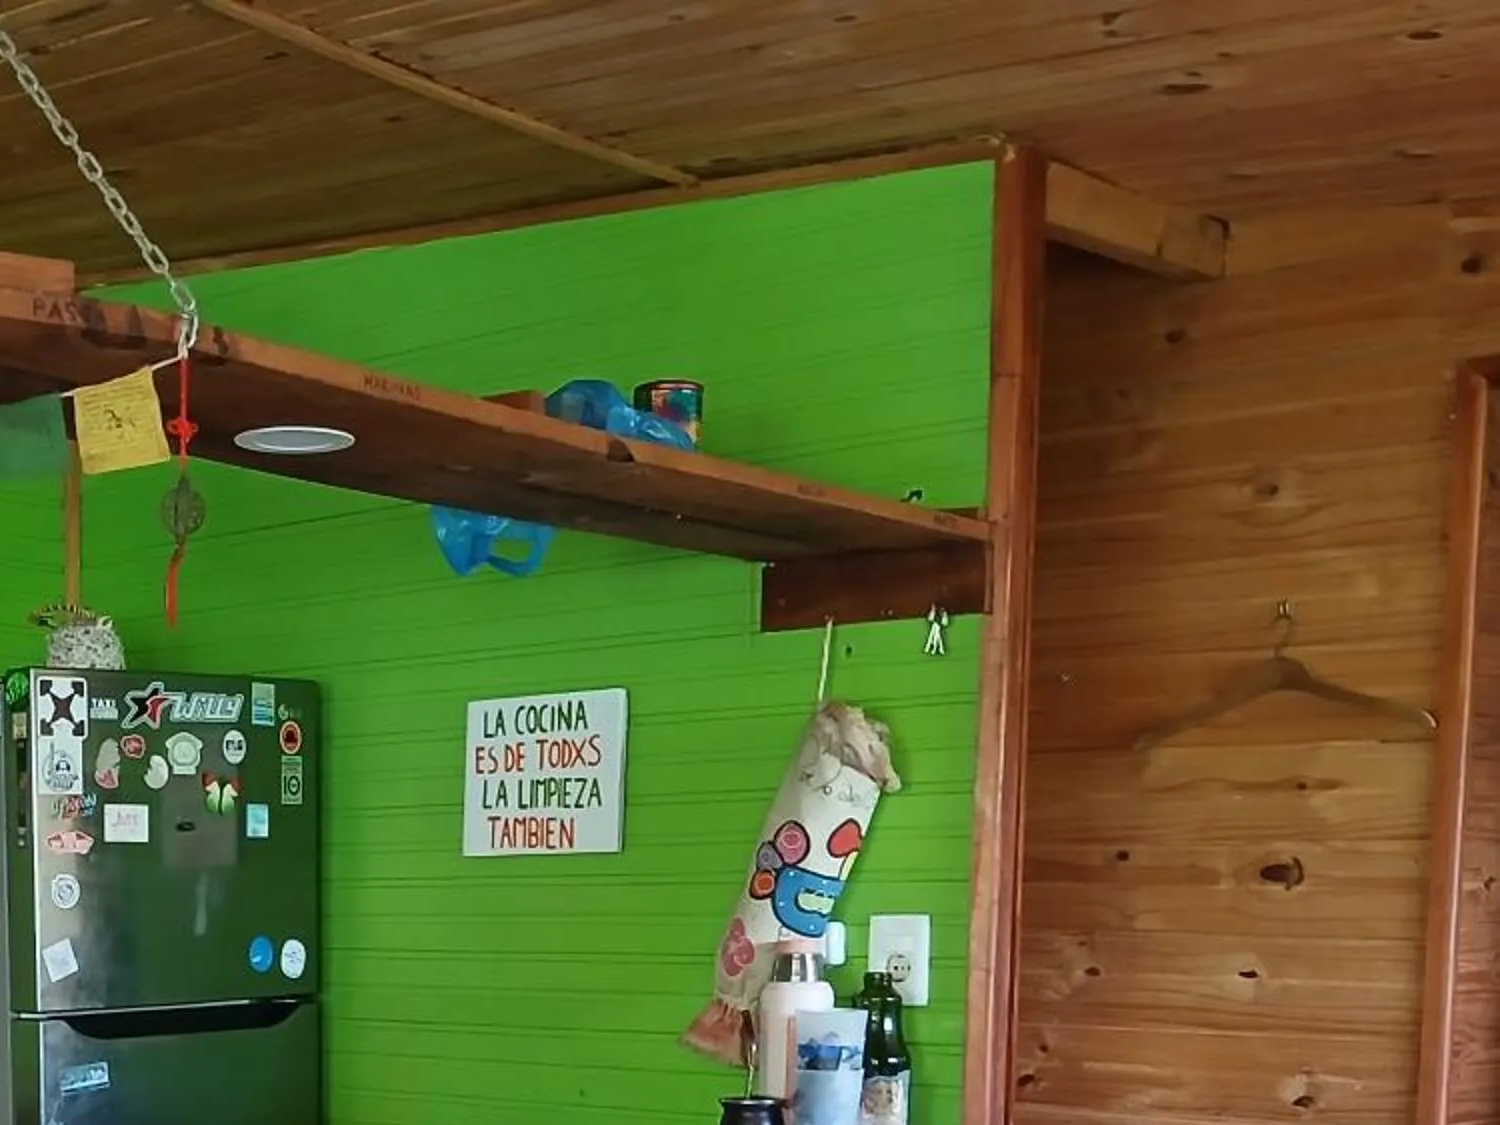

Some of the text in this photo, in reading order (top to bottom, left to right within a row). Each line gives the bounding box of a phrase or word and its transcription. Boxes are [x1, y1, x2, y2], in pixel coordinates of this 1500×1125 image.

[483, 700, 589, 738] LA COCINA
[475, 734, 602, 775] ES DE TODXS
[482, 777, 603, 809] LA LIMPIEZA
[487, 816, 575, 849] TAMBIEN
